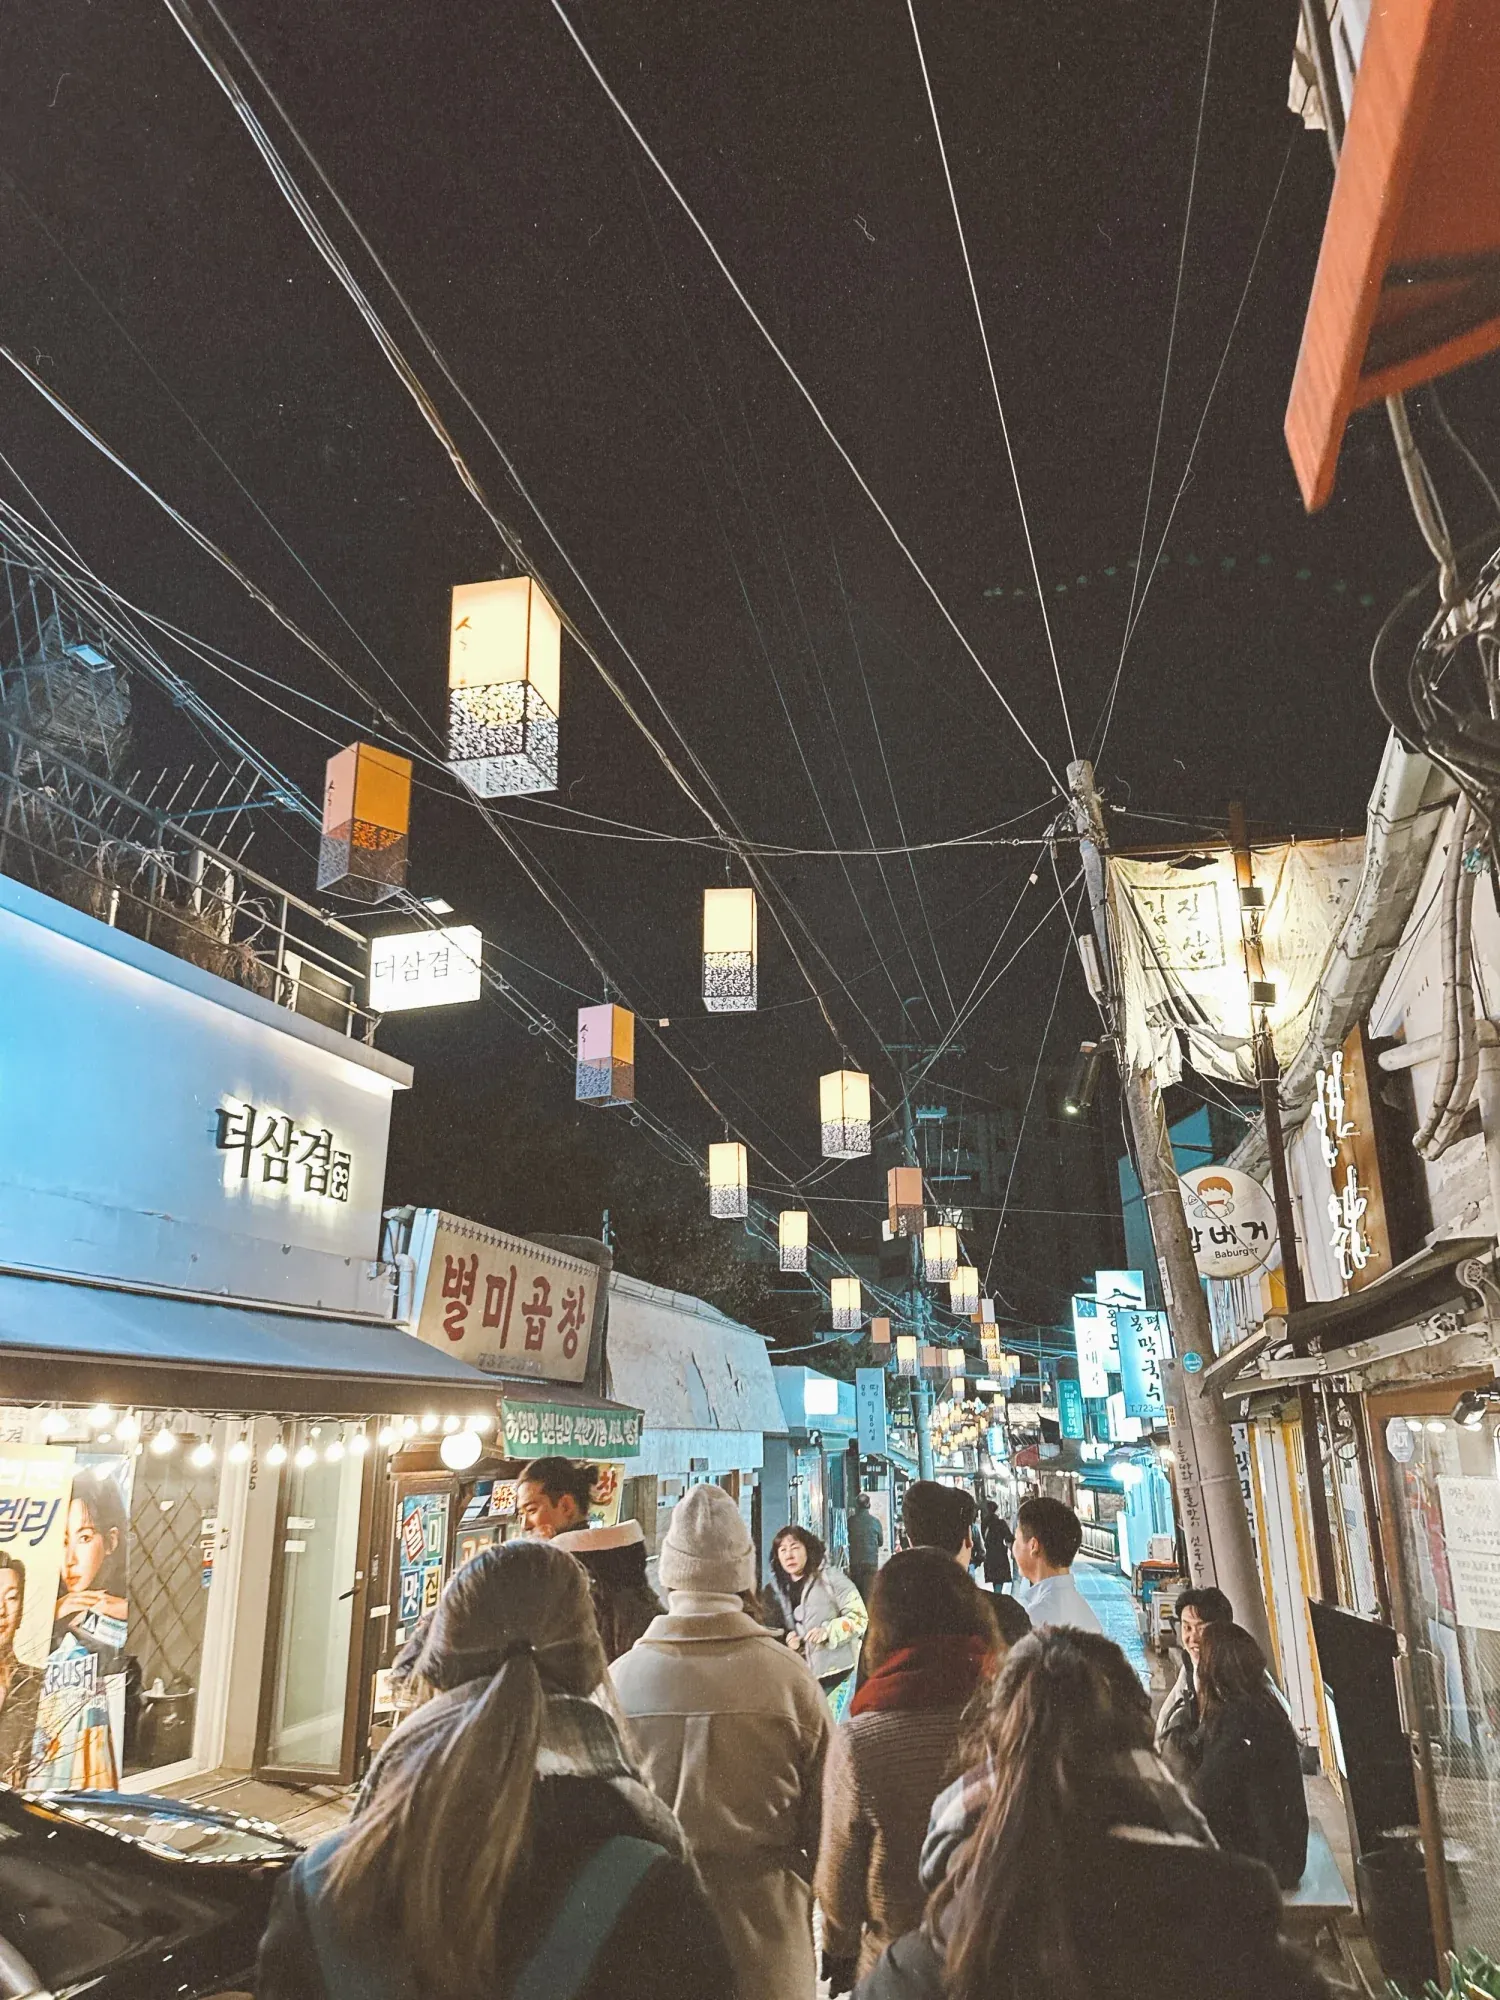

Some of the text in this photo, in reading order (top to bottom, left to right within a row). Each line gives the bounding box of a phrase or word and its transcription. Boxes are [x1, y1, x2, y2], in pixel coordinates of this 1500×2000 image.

[374, 948, 448, 983] 더삼겹
[215, 1104, 333, 1196] 더삼겹
[1214, 1246, 1259, 1259] Baburger
[442, 1253, 586, 1360] 별미곱창
